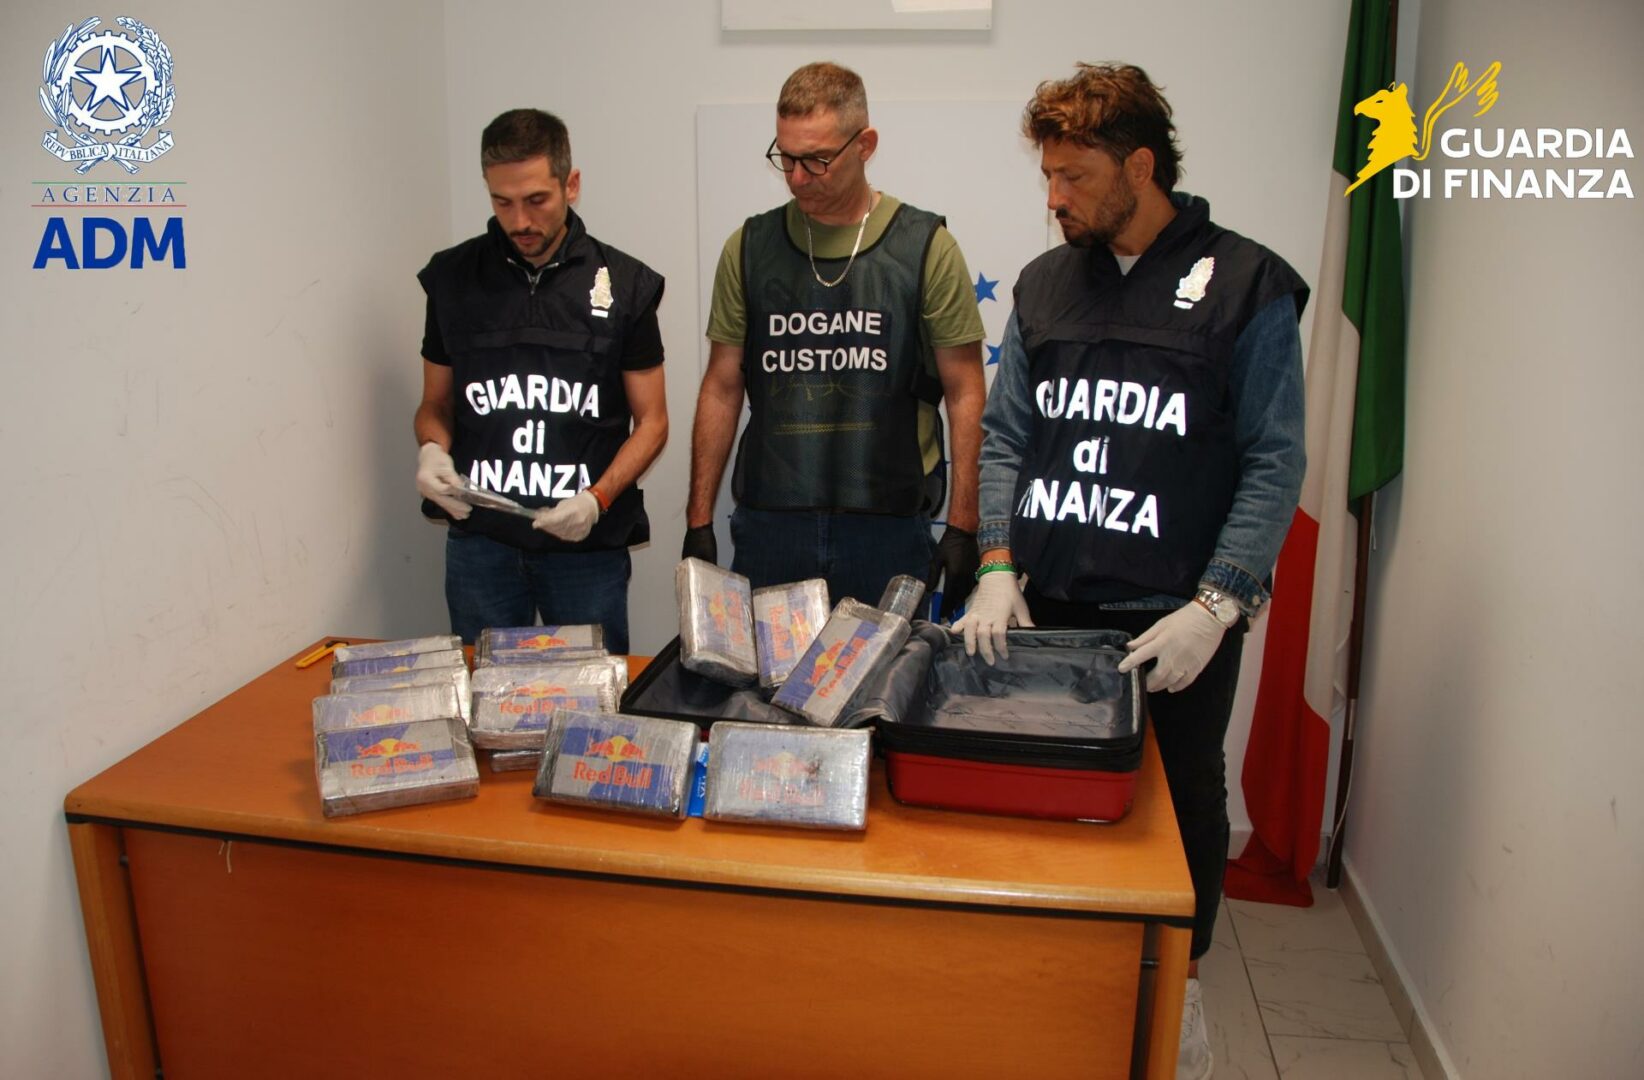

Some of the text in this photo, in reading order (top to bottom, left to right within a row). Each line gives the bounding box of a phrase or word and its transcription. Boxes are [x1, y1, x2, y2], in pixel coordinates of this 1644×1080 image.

[769, 310, 882, 336] DOGANE
[762, 347, 887, 373] CUSTOMS
[512, 419, 545, 454] di
[1073, 437, 1110, 474] di
[469, 459, 592, 498] INANZA
[1015, 478, 1159, 538] INANZA
[573, 761, 652, 789] Red Bull
